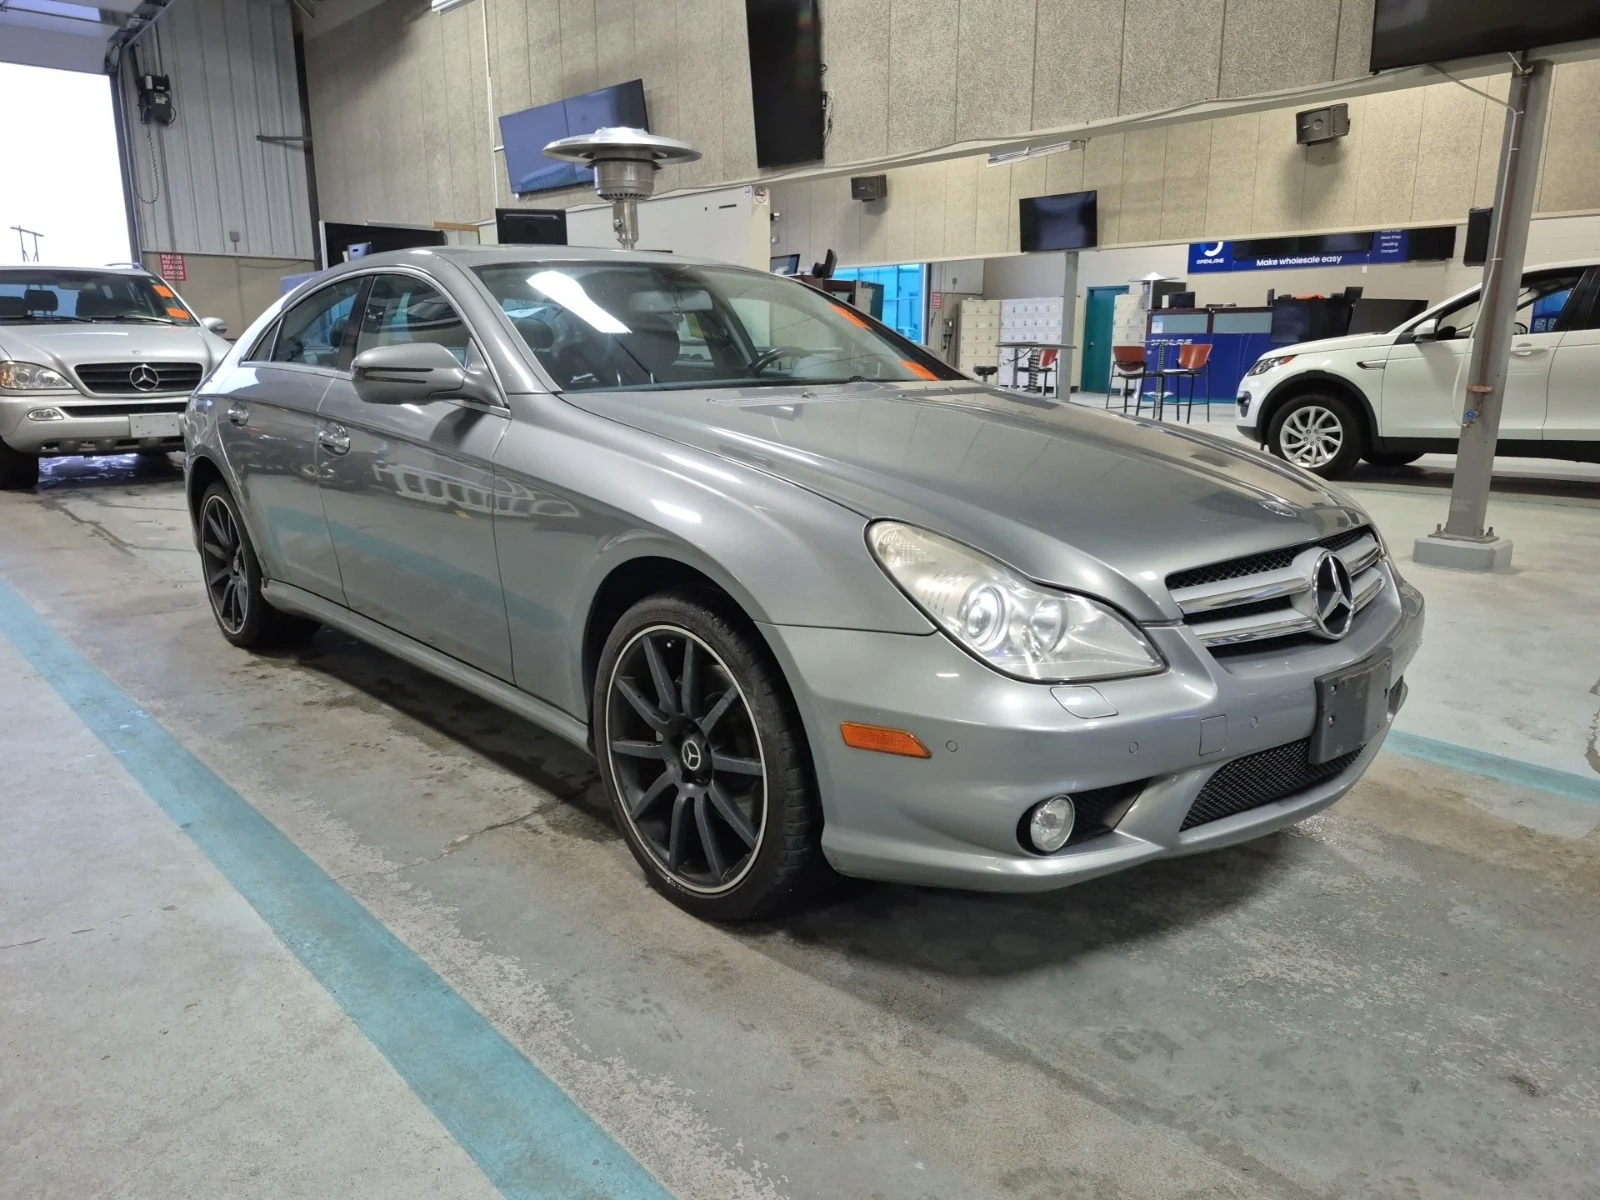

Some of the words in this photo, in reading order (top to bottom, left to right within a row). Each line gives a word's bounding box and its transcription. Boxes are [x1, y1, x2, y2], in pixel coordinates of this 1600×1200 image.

[1256, 258, 1279, 267] Make
[1279, 256, 1321, 265] wholesale
[1321, 255, 1343, 264] easy
